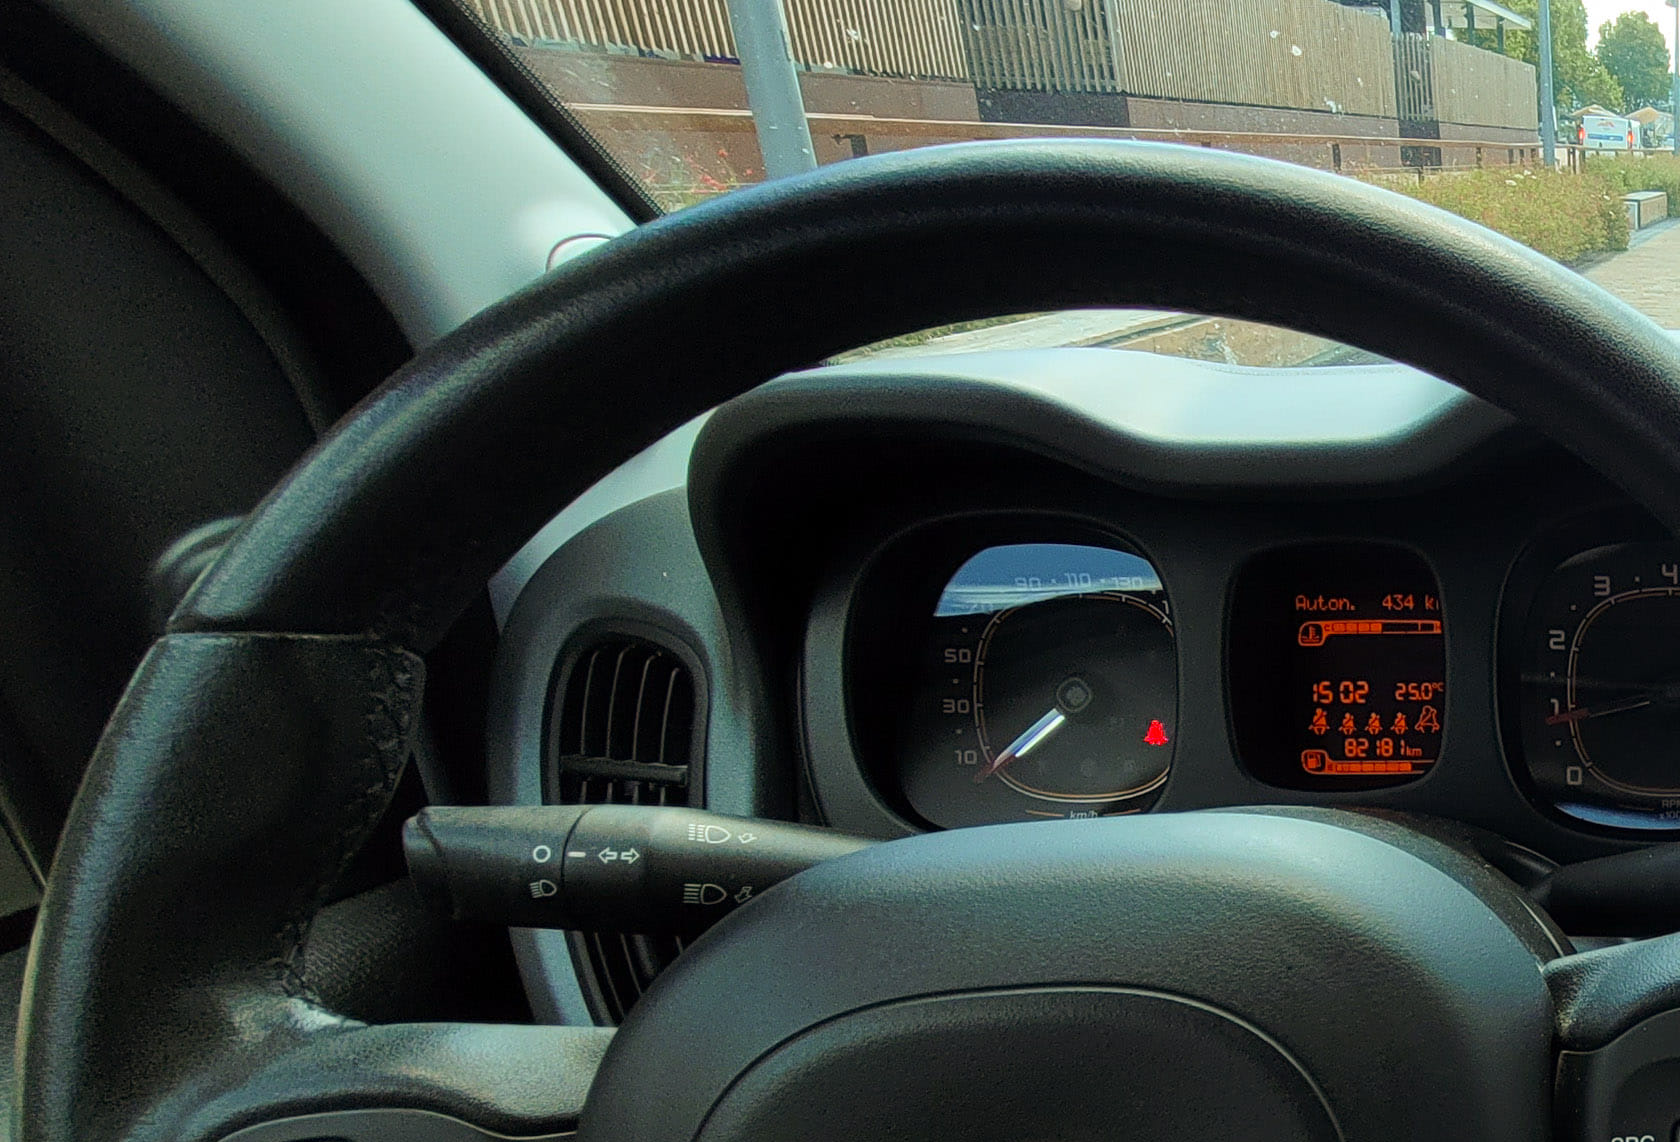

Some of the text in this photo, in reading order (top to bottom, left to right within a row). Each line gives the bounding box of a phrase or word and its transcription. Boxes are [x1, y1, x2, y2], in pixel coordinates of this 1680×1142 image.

[1064, 572, 1091, 588] 110
[1661, 563, 1679, 585] 4
[1594, 575, 1611, 596] 3
[1381, 593, 1415, 611] 434
[1549, 629, 1566, 650] 2
[944, 648, 971, 663] 50
[943, 698, 970, 714] 30
[954, 749, 978, 765] 10
